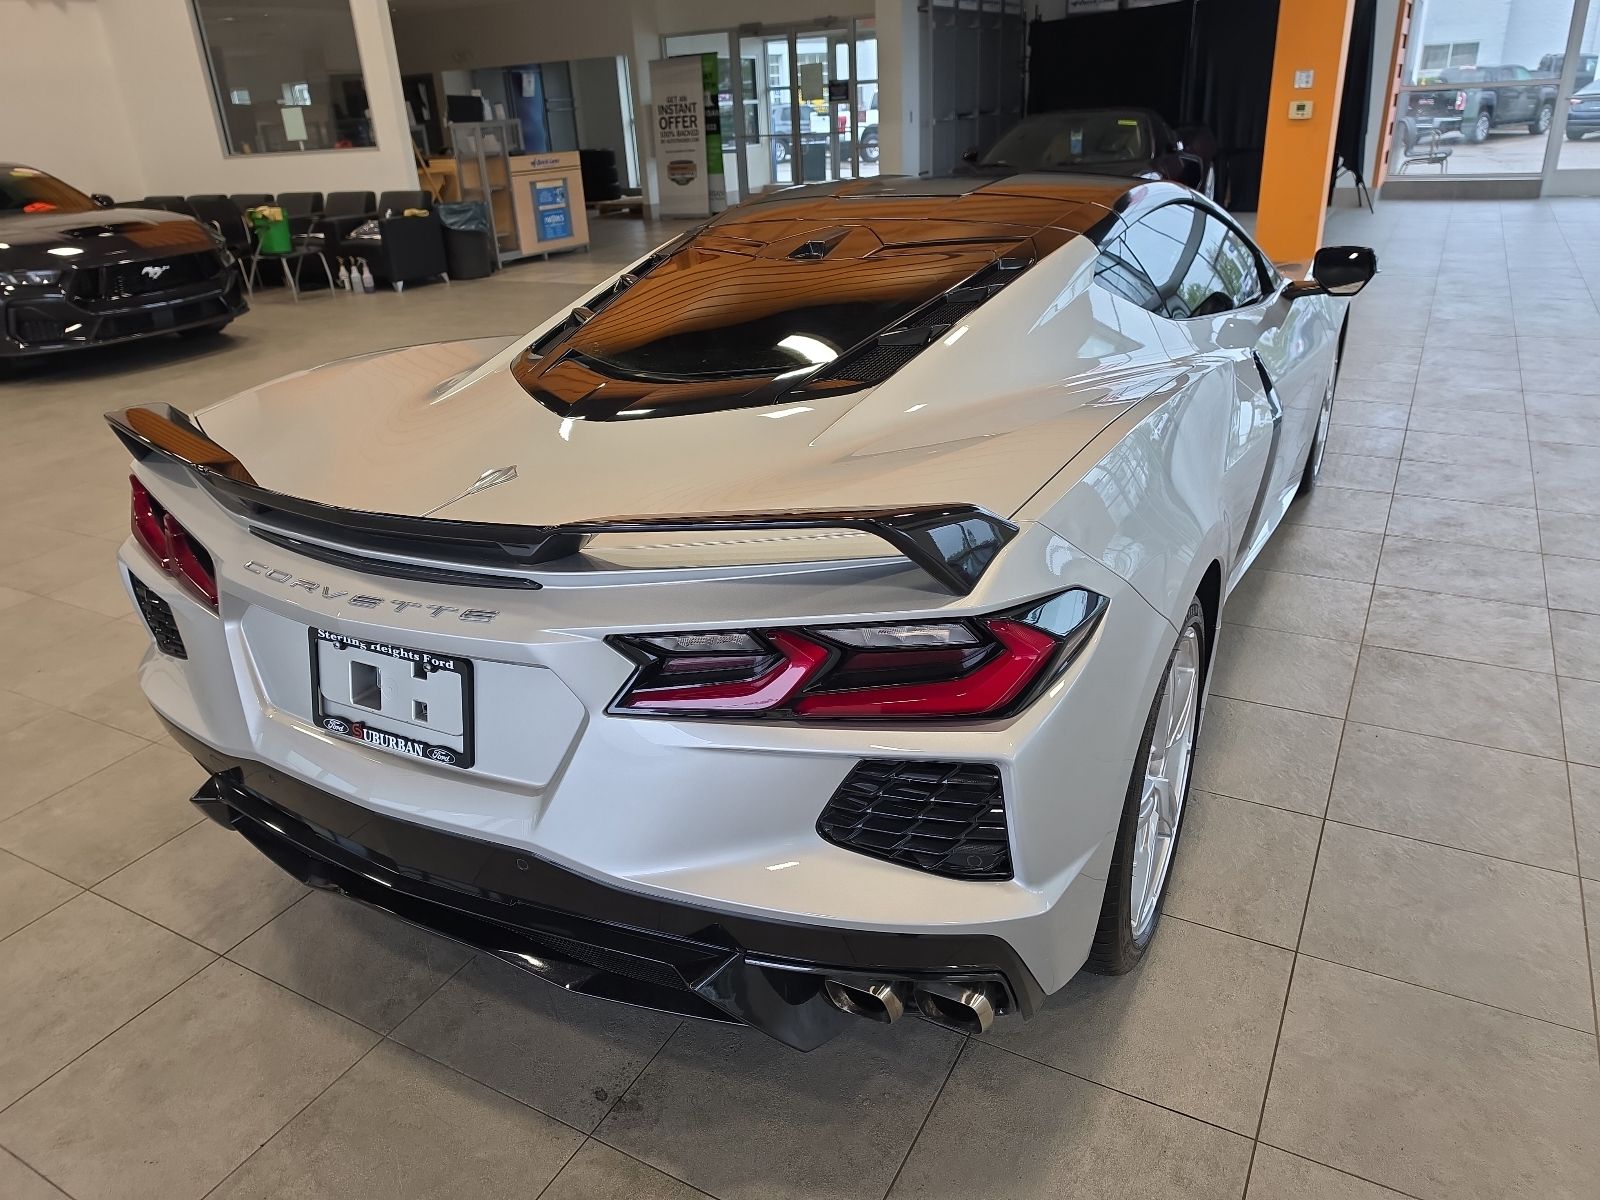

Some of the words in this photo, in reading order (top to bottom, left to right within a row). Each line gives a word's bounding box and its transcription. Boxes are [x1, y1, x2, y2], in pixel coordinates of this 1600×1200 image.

[657, 102, 697, 116] INSTANT
[659, 115, 698, 130] OFFER
[243, 559, 500, 624] CORVETTE
[317, 629, 366, 650] Sterling
[370, 643, 420, 661] Heights
[422, 653, 454, 669] Ford
[327, 719, 346, 732] Ford
[351, 723, 423, 756] SUBURBAN
[431, 748, 452, 763] Ford
